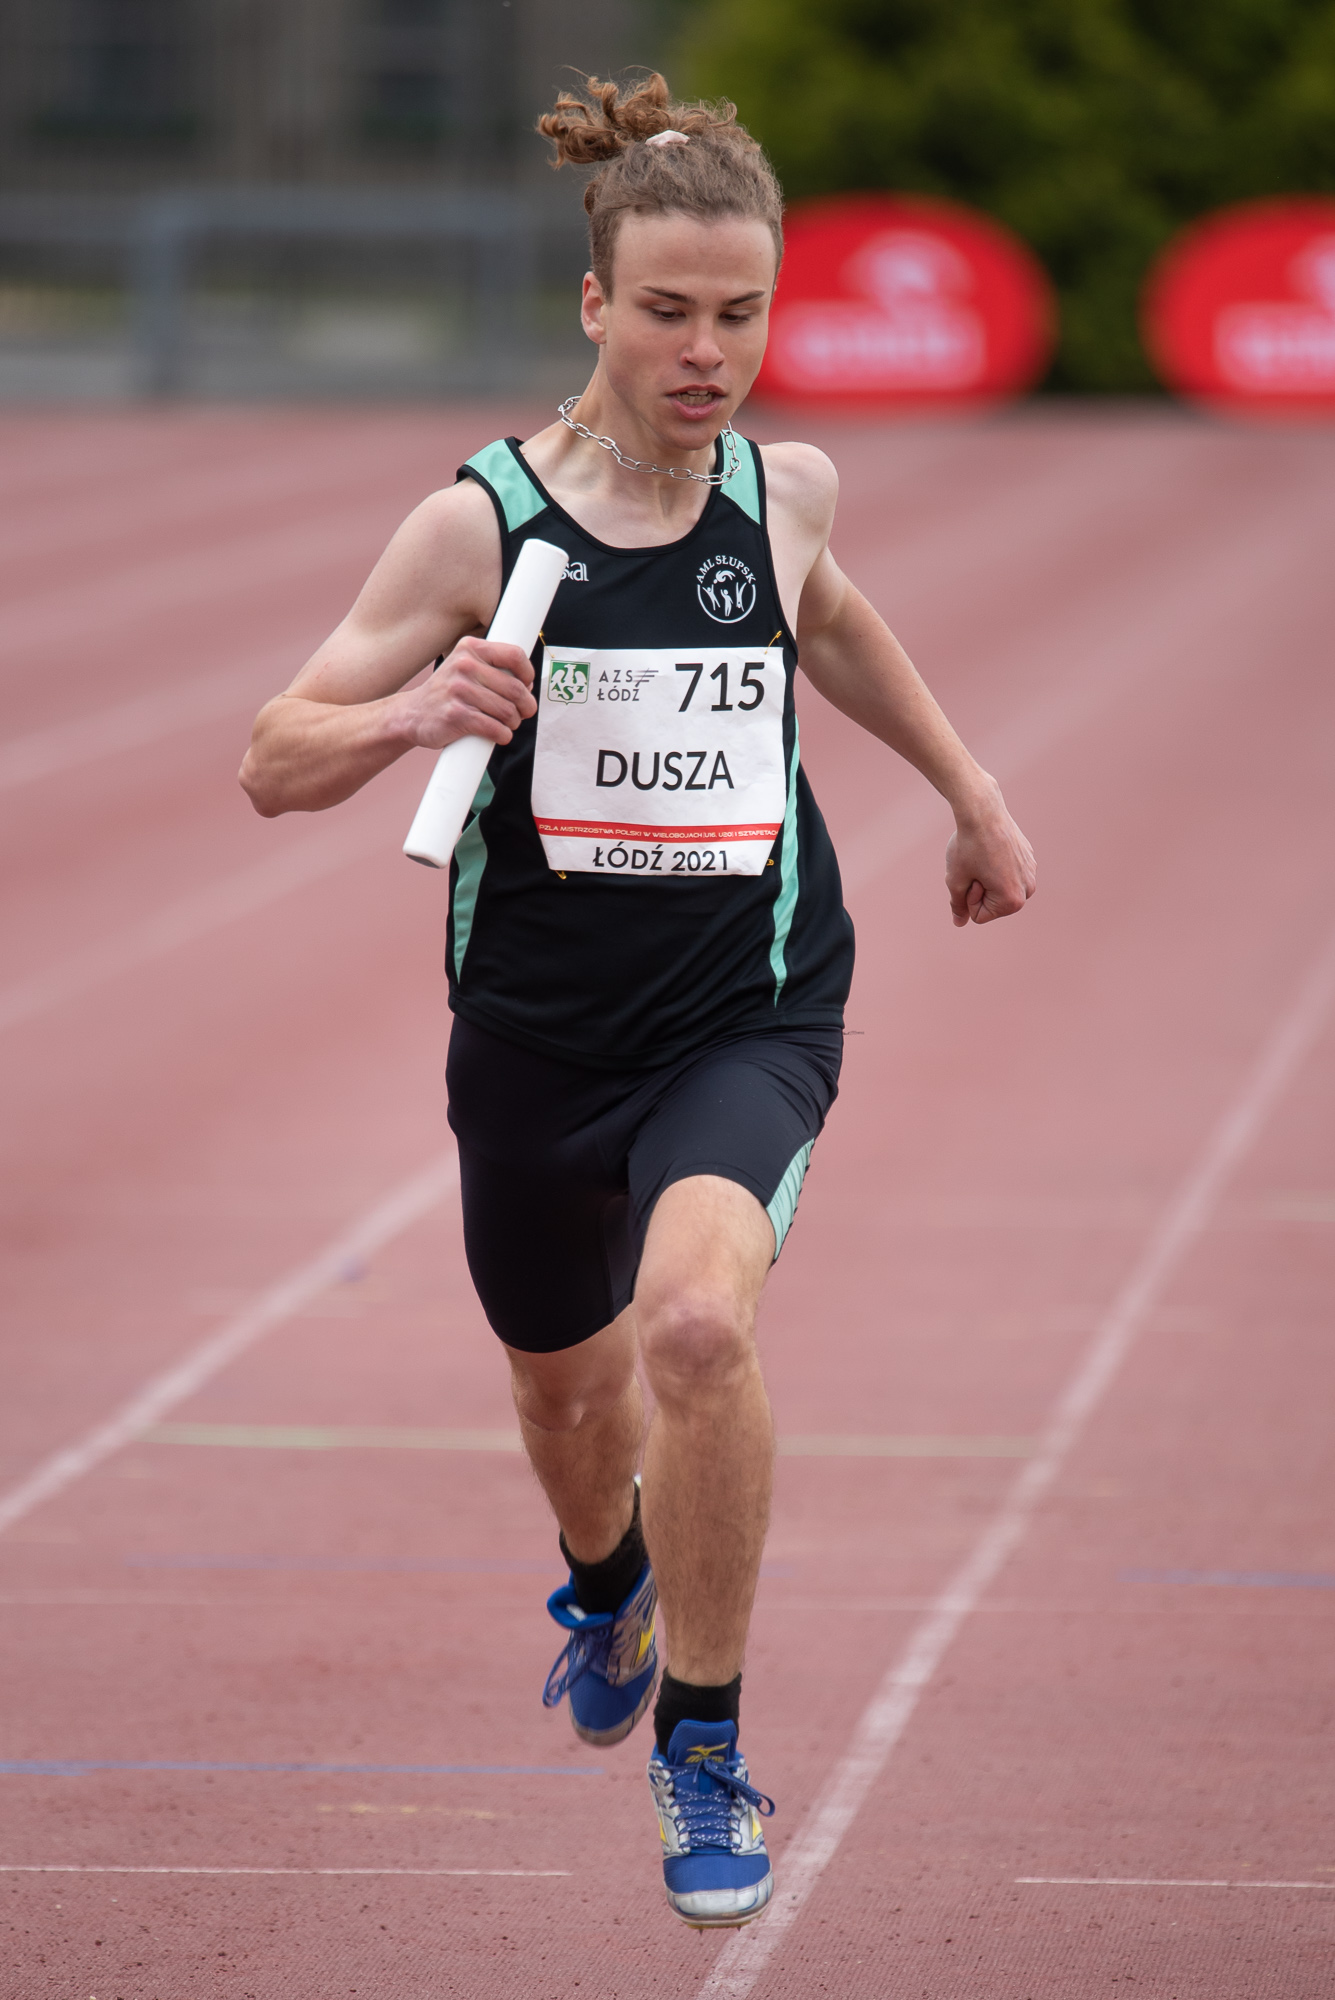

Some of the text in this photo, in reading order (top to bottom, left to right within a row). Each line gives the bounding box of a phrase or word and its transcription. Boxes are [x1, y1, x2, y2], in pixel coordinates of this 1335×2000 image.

[696, 554, 757, 584] AML SŁUPSK
[598, 669, 633, 683] AZS
[675, 662, 765, 713] 715
[596, 749, 735, 791] DUSZA
[538, 824, 558, 832] PZLA
[560, 825, 614, 835] MISTRZOSTWA
[615, 829, 642, 837] POLSKI
[592, 841, 728, 872] ŁÓDŹ 2021
